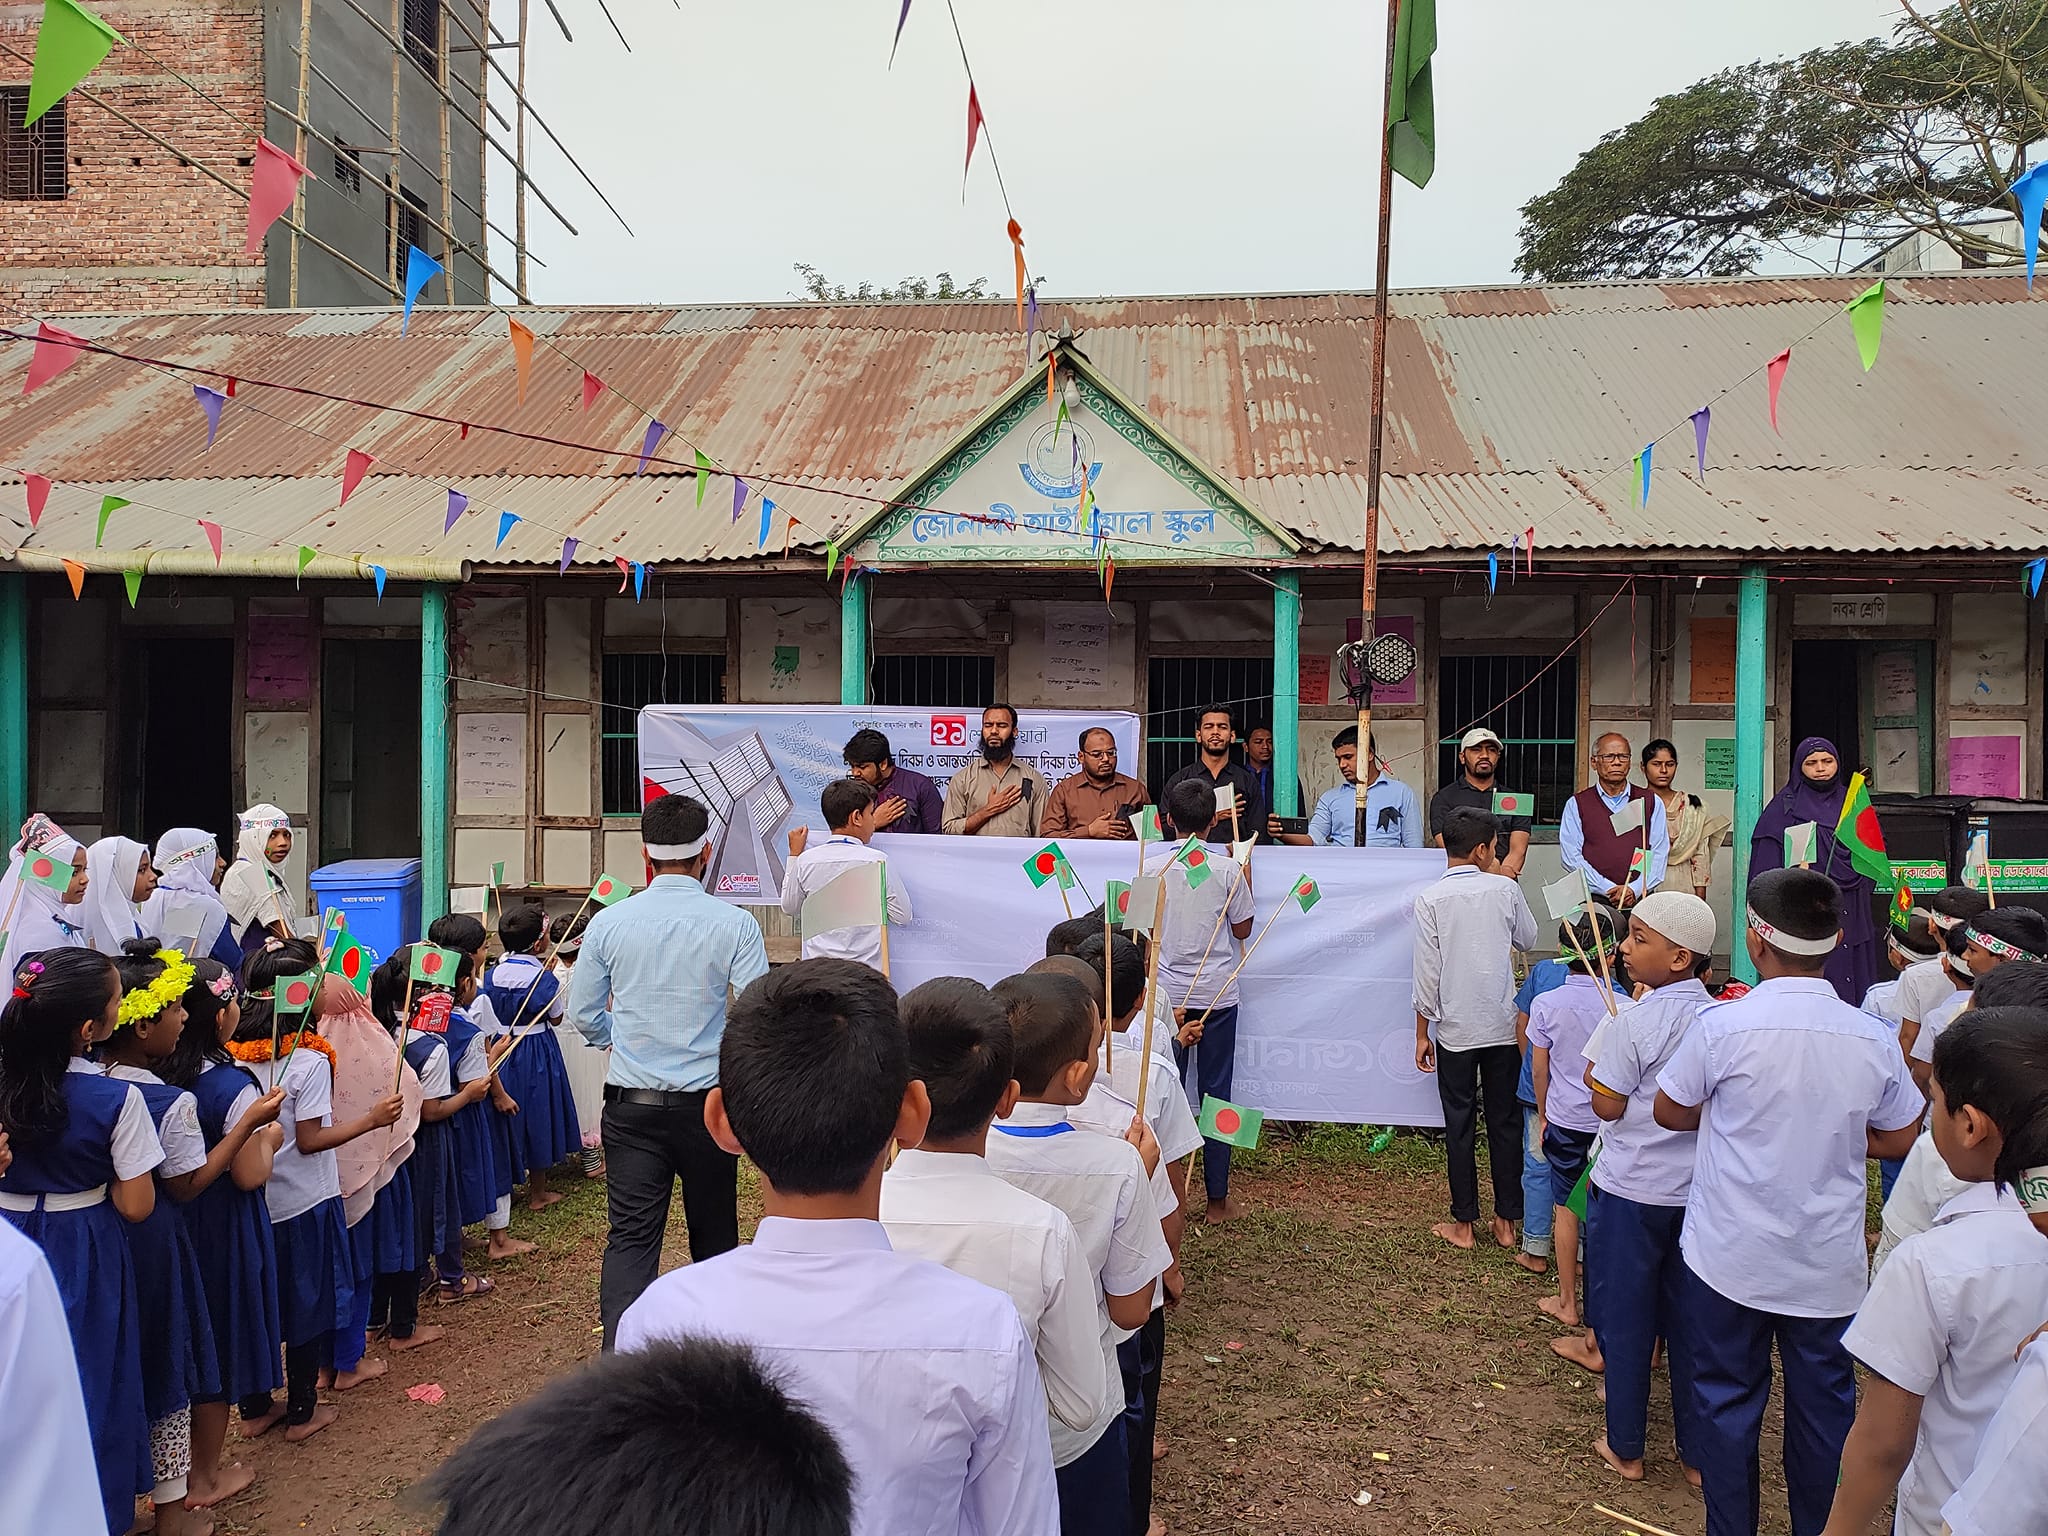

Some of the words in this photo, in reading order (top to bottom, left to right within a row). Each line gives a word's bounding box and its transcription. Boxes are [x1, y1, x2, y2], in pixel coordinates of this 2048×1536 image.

[1162, 508, 1216, 543] স্কুল
[1832, 602, 1857, 617] নবম
[899, 749, 924, 768] দিবস
[926, 754, 935, 767] ও
[1040, 750, 1066, 769] দিবস
